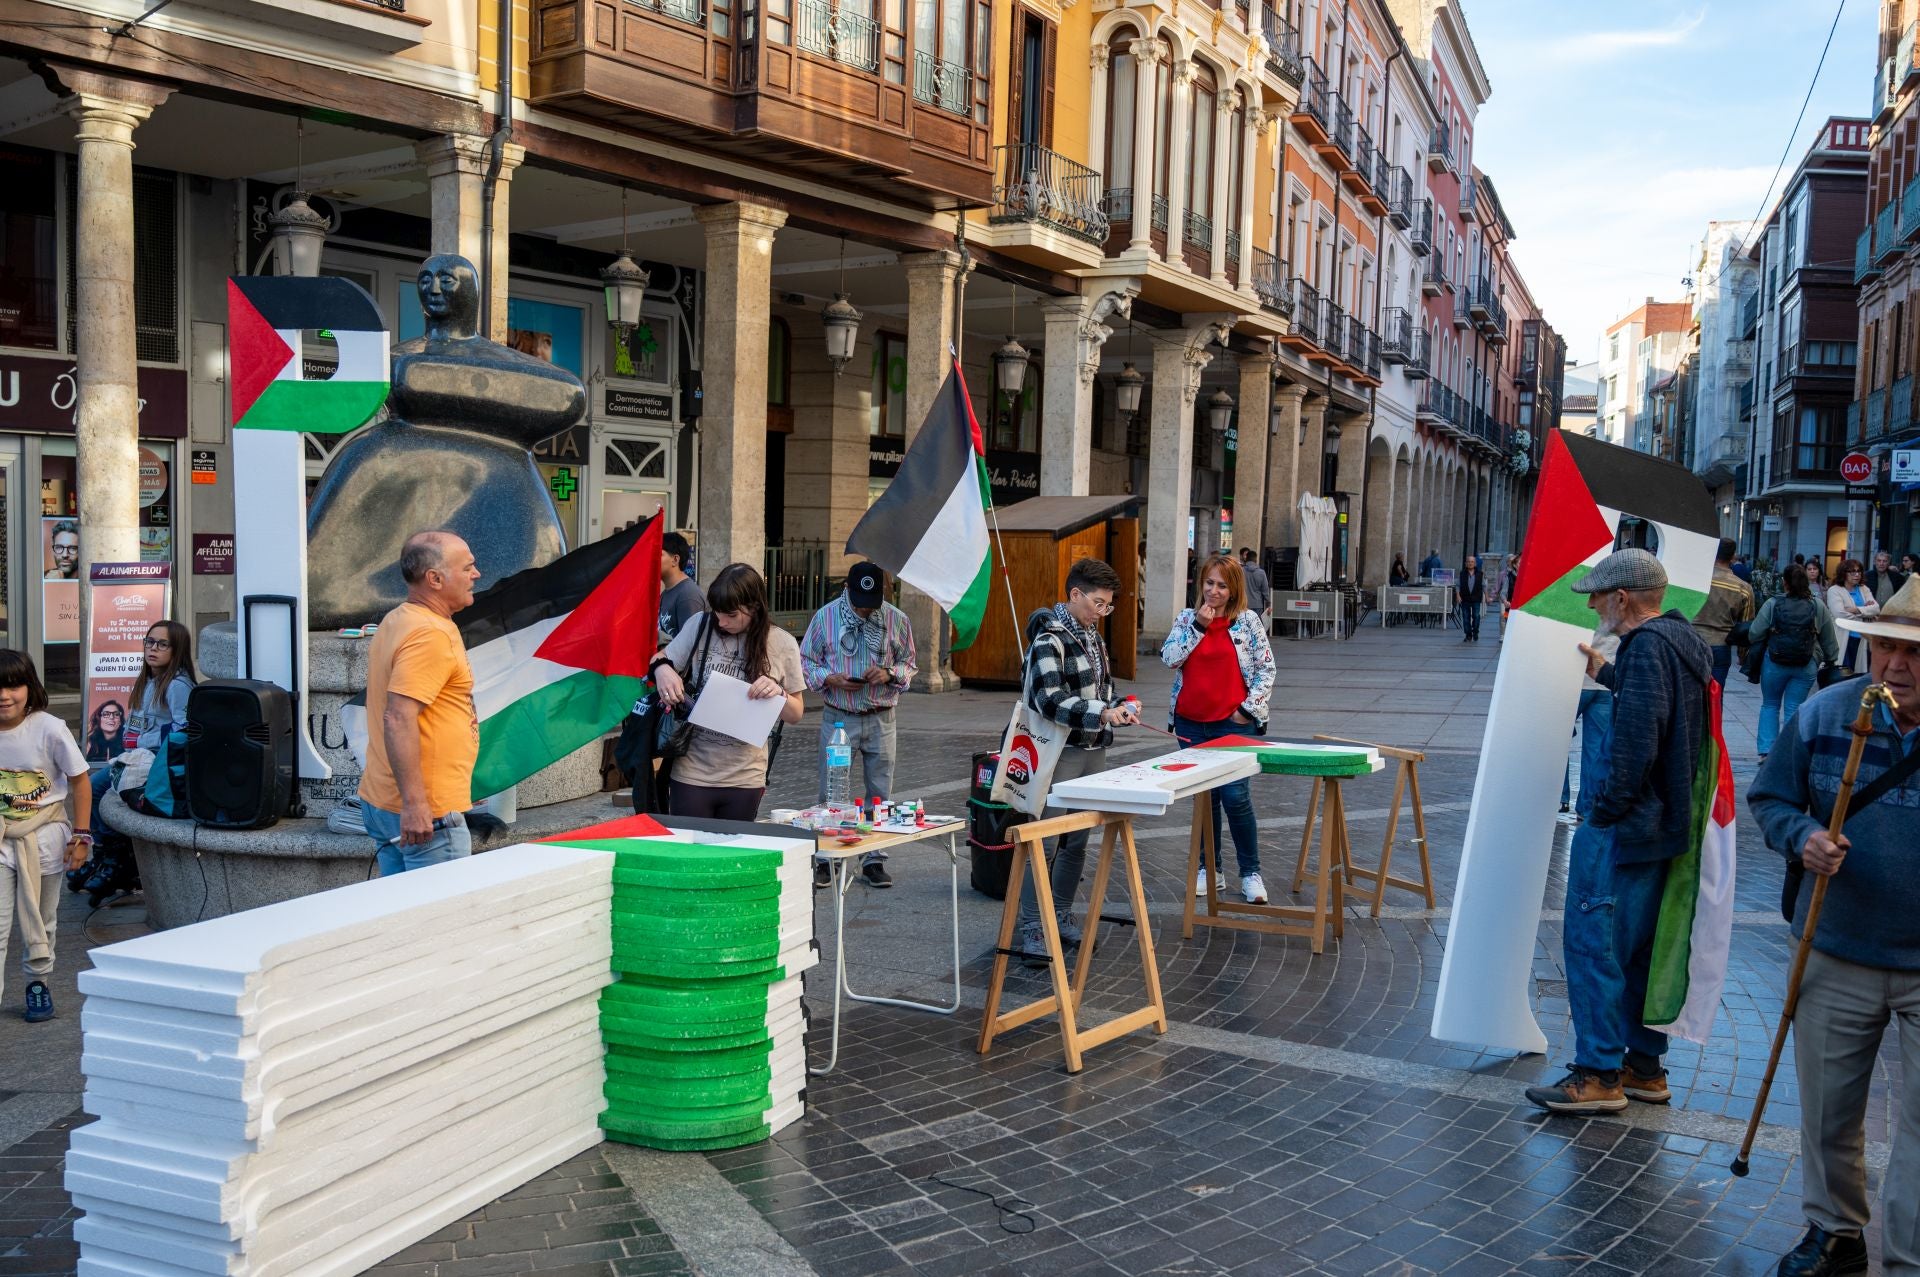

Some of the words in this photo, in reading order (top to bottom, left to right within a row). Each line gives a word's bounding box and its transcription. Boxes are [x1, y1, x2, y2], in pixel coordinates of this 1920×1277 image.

[615, 393, 662, 407] Dermoestética
[608, 402, 643, 414] Cosmética
[644, 406, 669, 417] Natural
[1844, 462, 1870, 474] BAR
[209, 539, 233, 548] ALAIN
[196, 547, 233, 556] AFFLELOU
[979, 768, 992, 780] ALTO
[1007, 764, 1027, 781] CGT
[312, 788, 358, 798] PALENCI
